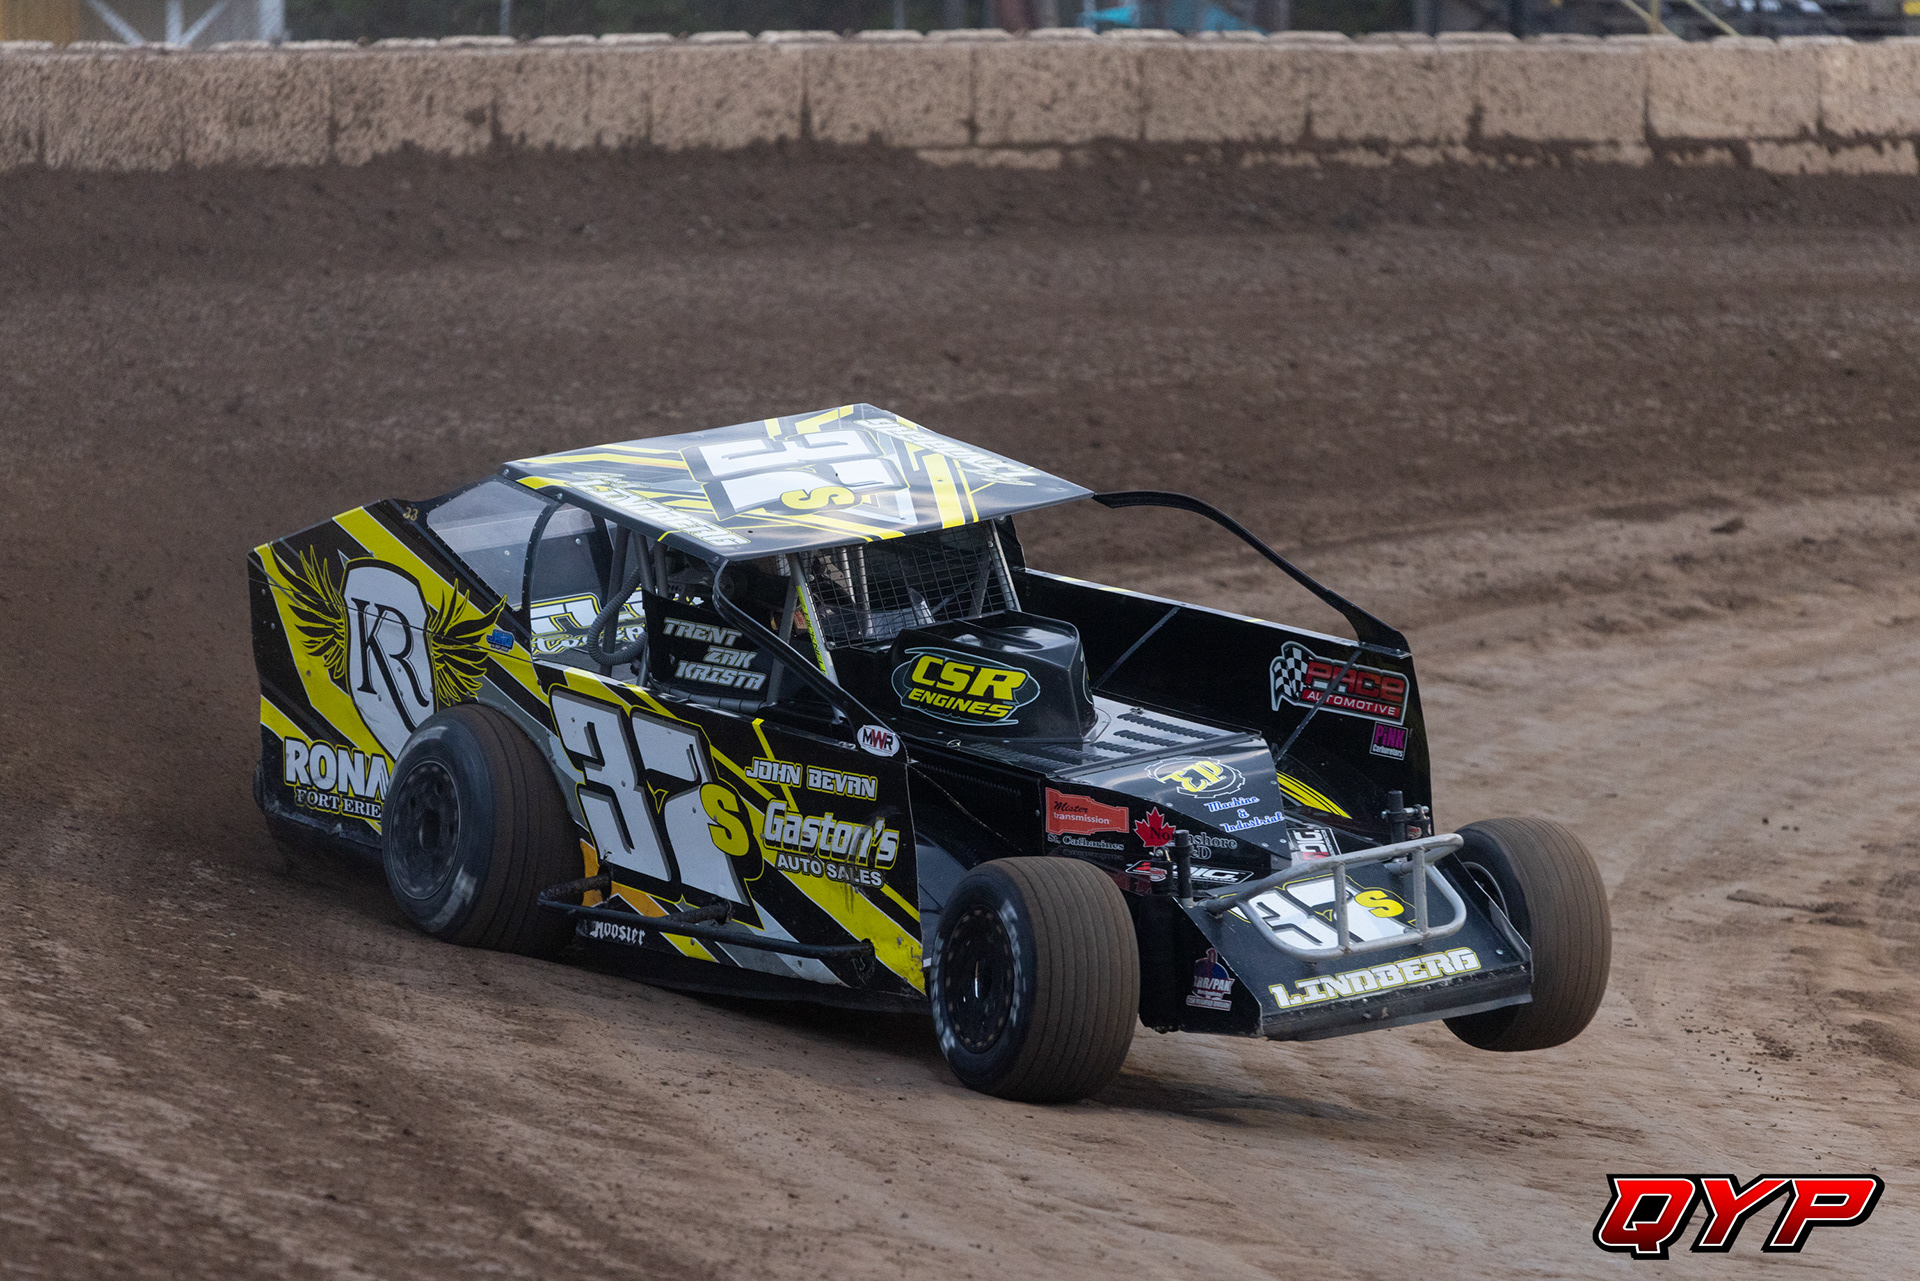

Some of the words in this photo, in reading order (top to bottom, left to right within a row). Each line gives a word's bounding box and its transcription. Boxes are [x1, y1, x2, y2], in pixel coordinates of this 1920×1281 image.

[663, 618, 742, 646] TRENT
[703, 646, 757, 669] ZAK
[675, 660, 766, 690] KRISTA
[911, 655, 1017, 701] CSR
[908, 687, 1014, 718] ENGINES
[862, 728, 895, 751] MWR
[745, 759, 802, 786] JOHN
[807, 768, 877, 799] BEVAN
[296, 787, 340, 810] FORT
[343, 797, 382, 819] ERIE
[1053, 801, 1089, 814] Mister
[1204, 796, 1261, 813] Machine
[1237, 808, 1250, 819] &
[763, 800, 899, 863] Gaston's
[1053, 811, 1110, 825] transmission
[1219, 811, 1285, 834] Industrial
[1062, 835, 1125, 851] Catharines
[777, 853, 823, 876] AUTO
[826, 863, 883, 887] SALES
[1269, 947, 1481, 1008] LINDBERG
